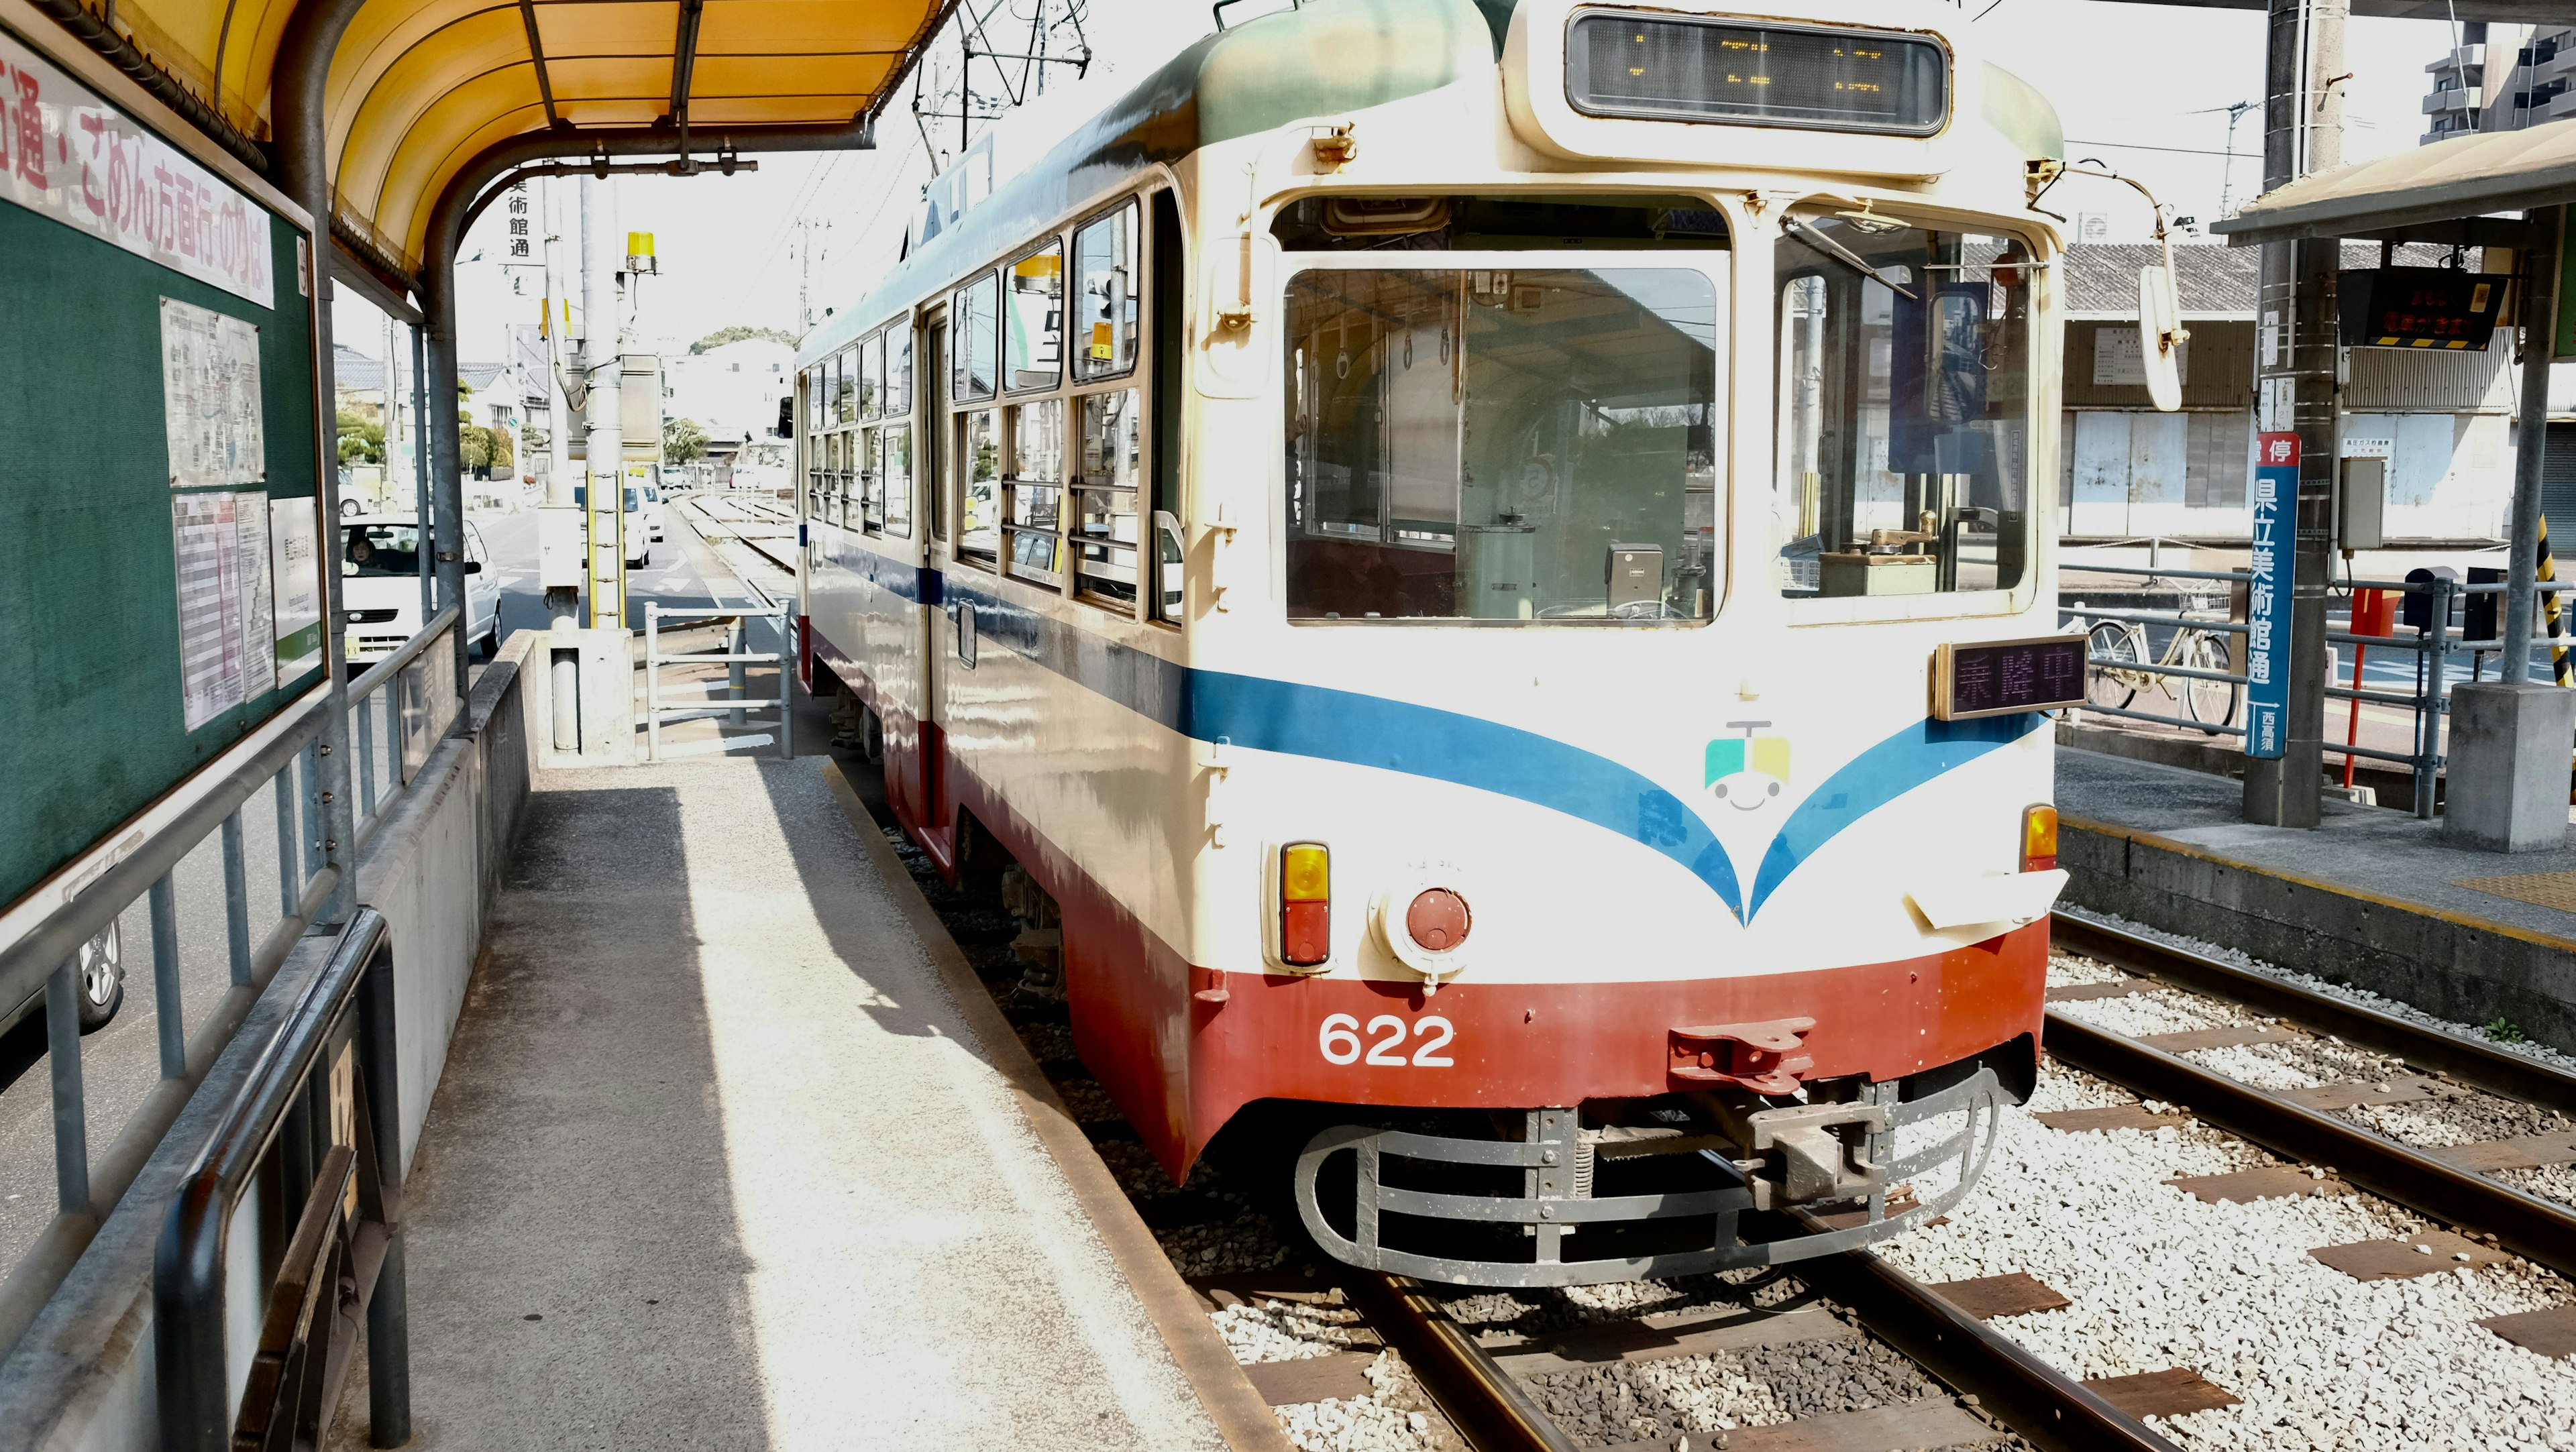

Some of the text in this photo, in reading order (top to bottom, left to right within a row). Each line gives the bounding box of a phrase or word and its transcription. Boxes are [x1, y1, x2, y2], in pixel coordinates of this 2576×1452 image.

[2248, 478, 2277, 685] 県立美術館通
[1956, 646, 2074, 704] 乗降中
[2261, 711, 2275, 751] 西高須
[1319, 1013, 1454, 1067] 622
